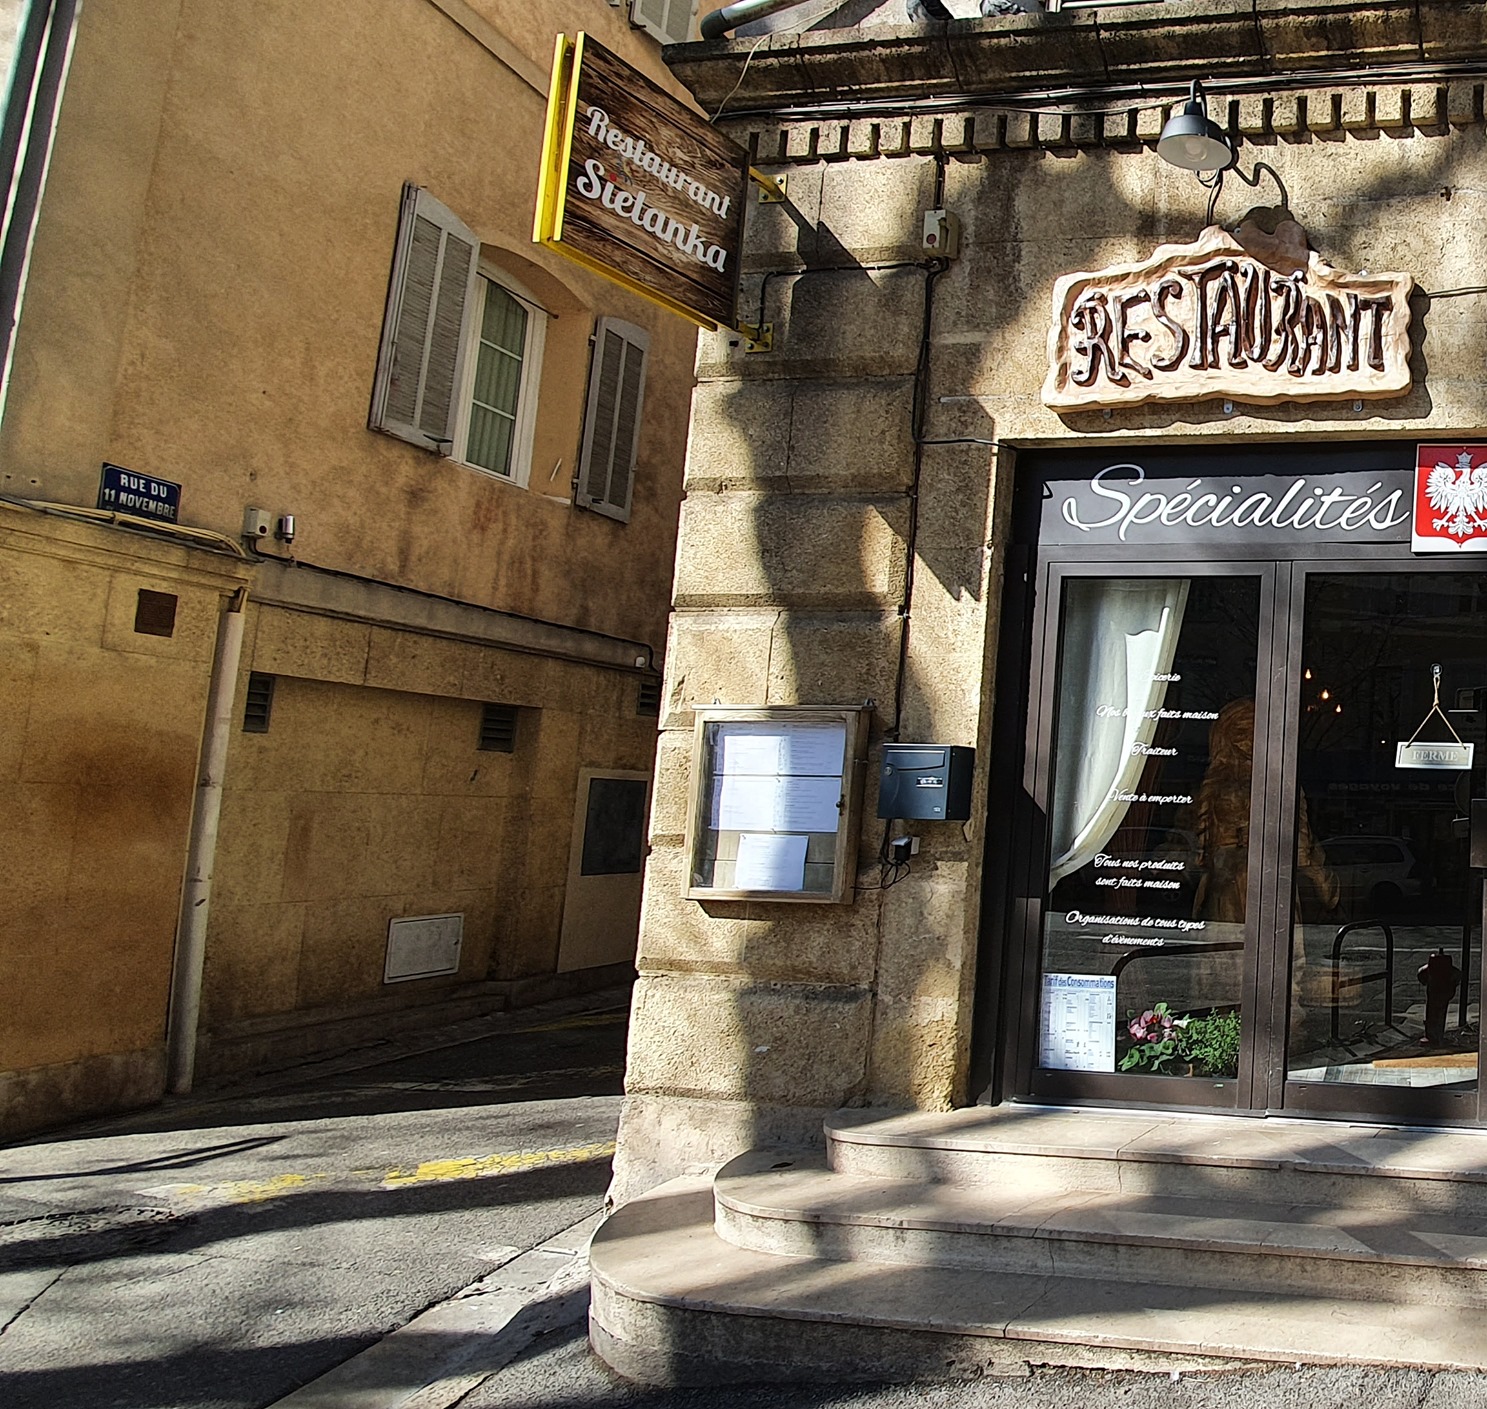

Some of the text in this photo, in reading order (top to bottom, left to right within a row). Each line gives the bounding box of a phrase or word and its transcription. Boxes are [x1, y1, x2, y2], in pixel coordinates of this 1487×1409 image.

[586, 106, 731, 219] Restaurant
[576, 158, 728, 273] Sielanka
[1070, 258, 1394, 387] RESTAURANT
[120, 474, 167, 498] RUE DU
[104, 488, 175, 518] 11 NOVEMBRE
[1062, 463, 1411, 541] Spécialités
[1096, 704, 1121, 719] Nos
[1153, 707, 1181, 721] faits
[1182, 710, 1219, 720] maison
[1131, 741, 1178, 756] Traiteur
[1110, 788, 1193, 805] Vente à emporter
[1094, 853, 1185, 871] Tous nos produits
[1095, 876, 1180, 889] sont faits maison
[1065, 910, 1206, 932] Organisations de tous types
[1044, 975, 1059, 987] Tarif
[1067, 976, 1115, 989] Consommations
